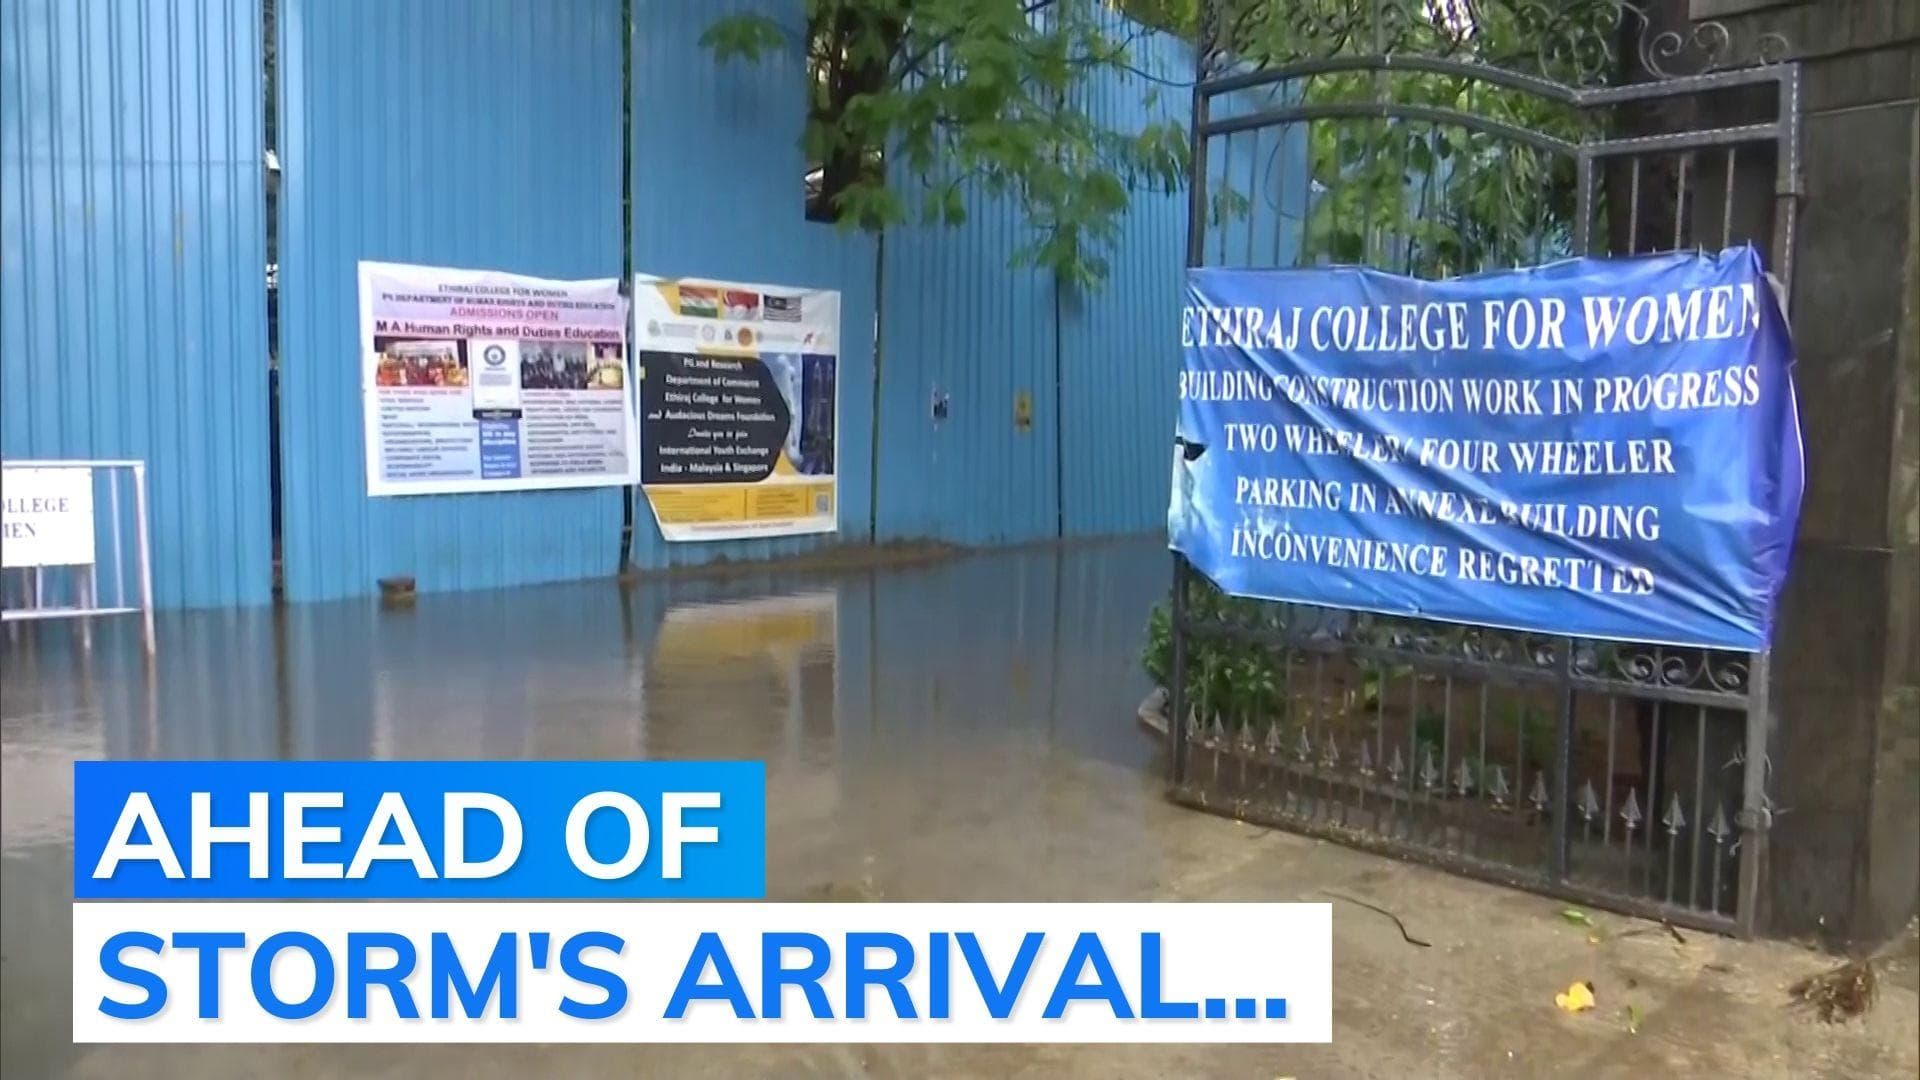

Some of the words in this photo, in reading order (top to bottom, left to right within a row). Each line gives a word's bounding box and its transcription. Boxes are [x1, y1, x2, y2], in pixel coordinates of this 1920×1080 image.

[376, 320, 387, 332] M
[391, 321, 401, 332] A
[404, 322, 450, 335] Human
[453, 324, 493, 338] Rights
[496, 325, 520, 337] and
[522, 326, 561, 339] Duties
[564, 327, 620, 340] Education
[450, 307, 523, 319] ADMISSIONS
[526, 309, 559, 321] OPEN
[1181, 302, 1301, 350] ETHIRAJ
[1310, 302, 1470, 352] COLLEGE
[1482, 298, 1567, 351] FOR
[1583, 282, 1761, 350] WOMEN
[665, 374, 711, 387] Department
[1179, 367, 1272, 401] BUILDING
[1273, 374, 1454, 413] CONSTRUCTION
[1461, 378, 1542, 415] WORK
[1551, 378, 1583, 415] IN
[1593, 364, 1760, 414] PROGRESS
[659, 445, 712, 456] International
[1224, 423, 1278, 452] TWO
[1420, 438, 1501, 474] FOUR
[1508, 438, 1676, 475] WHEELER
[660, 462, 683, 473] India
[689, 462, 723, 475] Malaysia
[1235, 476, 1342, 511] PARKING
[1349, 482, 1376, 513] IN
[1499, 501, 1660, 541] BUILDING
[1231, 526, 1448, 577] INCONVENIENCE
[1457, 548, 1655, 596] REGRETTED
